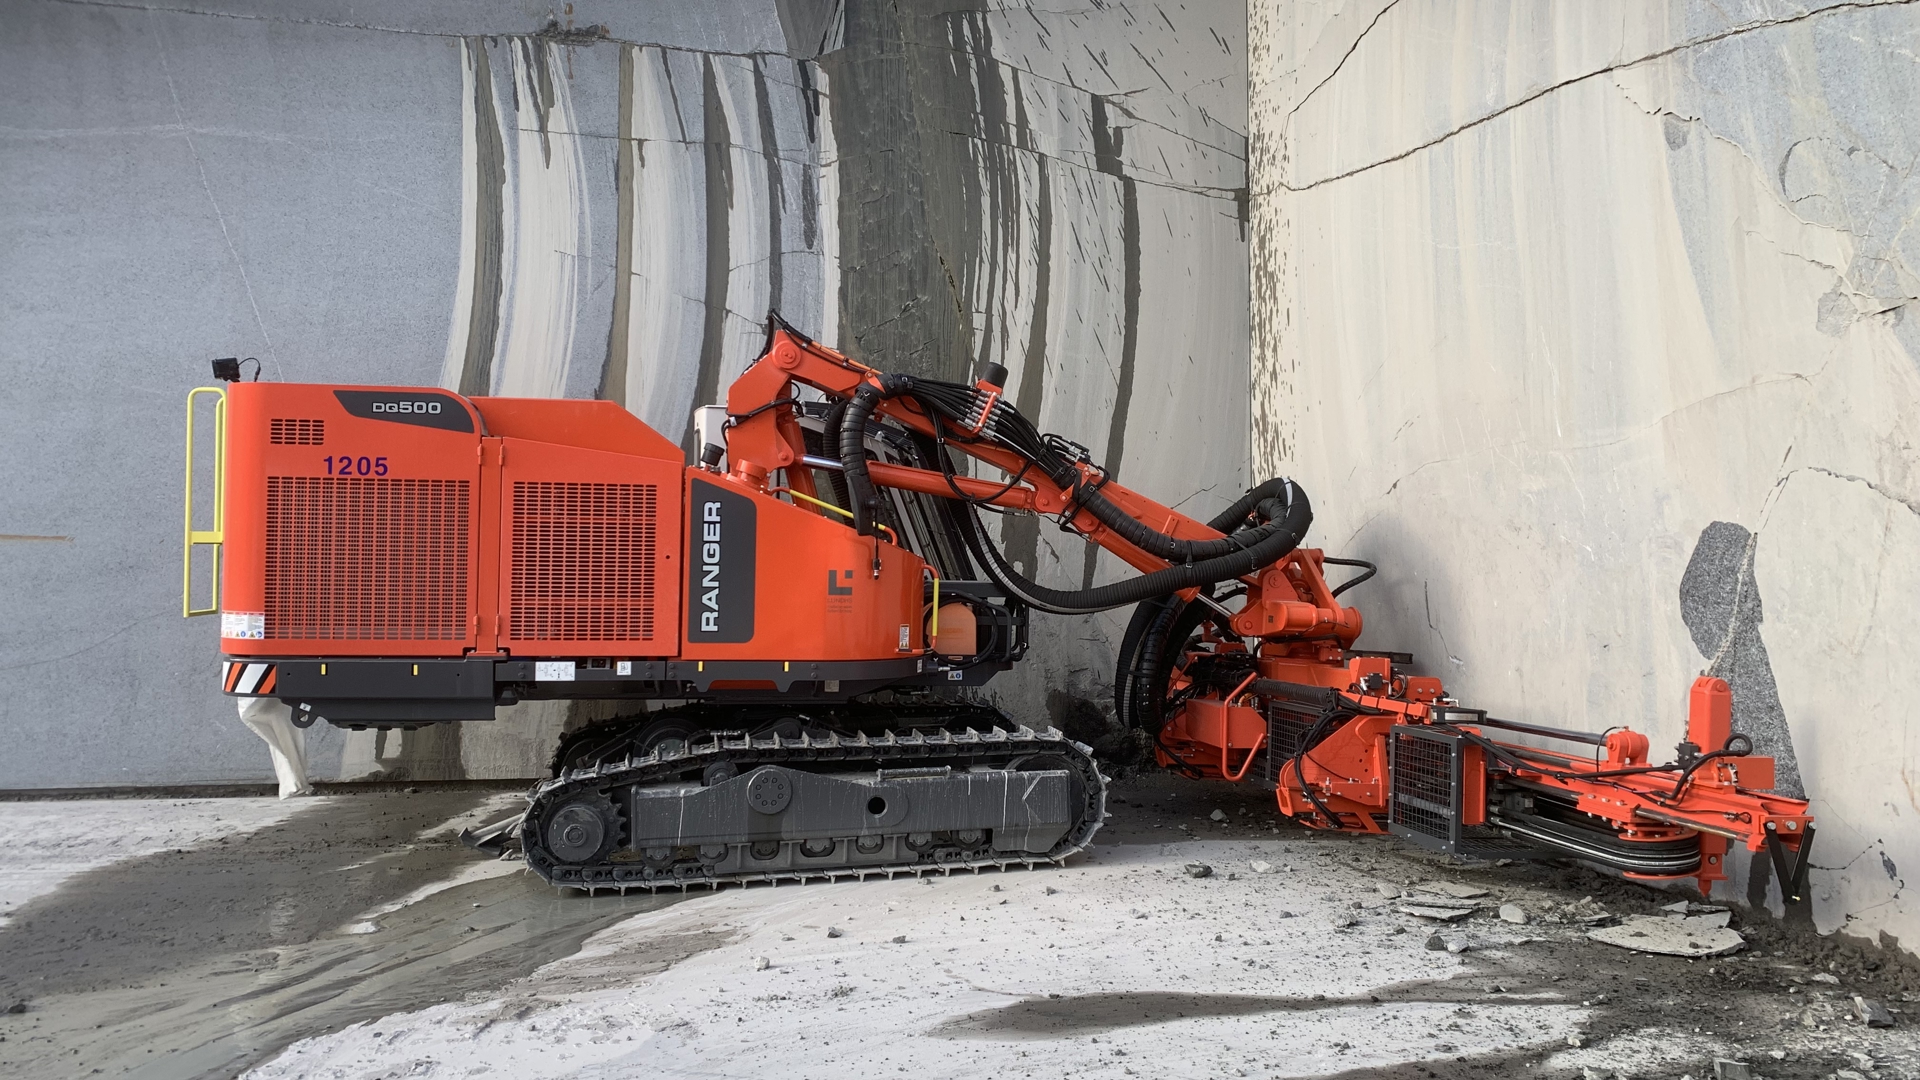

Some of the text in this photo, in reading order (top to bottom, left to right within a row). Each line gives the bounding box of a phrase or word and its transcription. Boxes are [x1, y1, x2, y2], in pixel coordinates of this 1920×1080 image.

[372, 401, 442, 414] DQ500
[323, 455, 389, 477] 1205
[700, 501, 722, 632] RANGER
